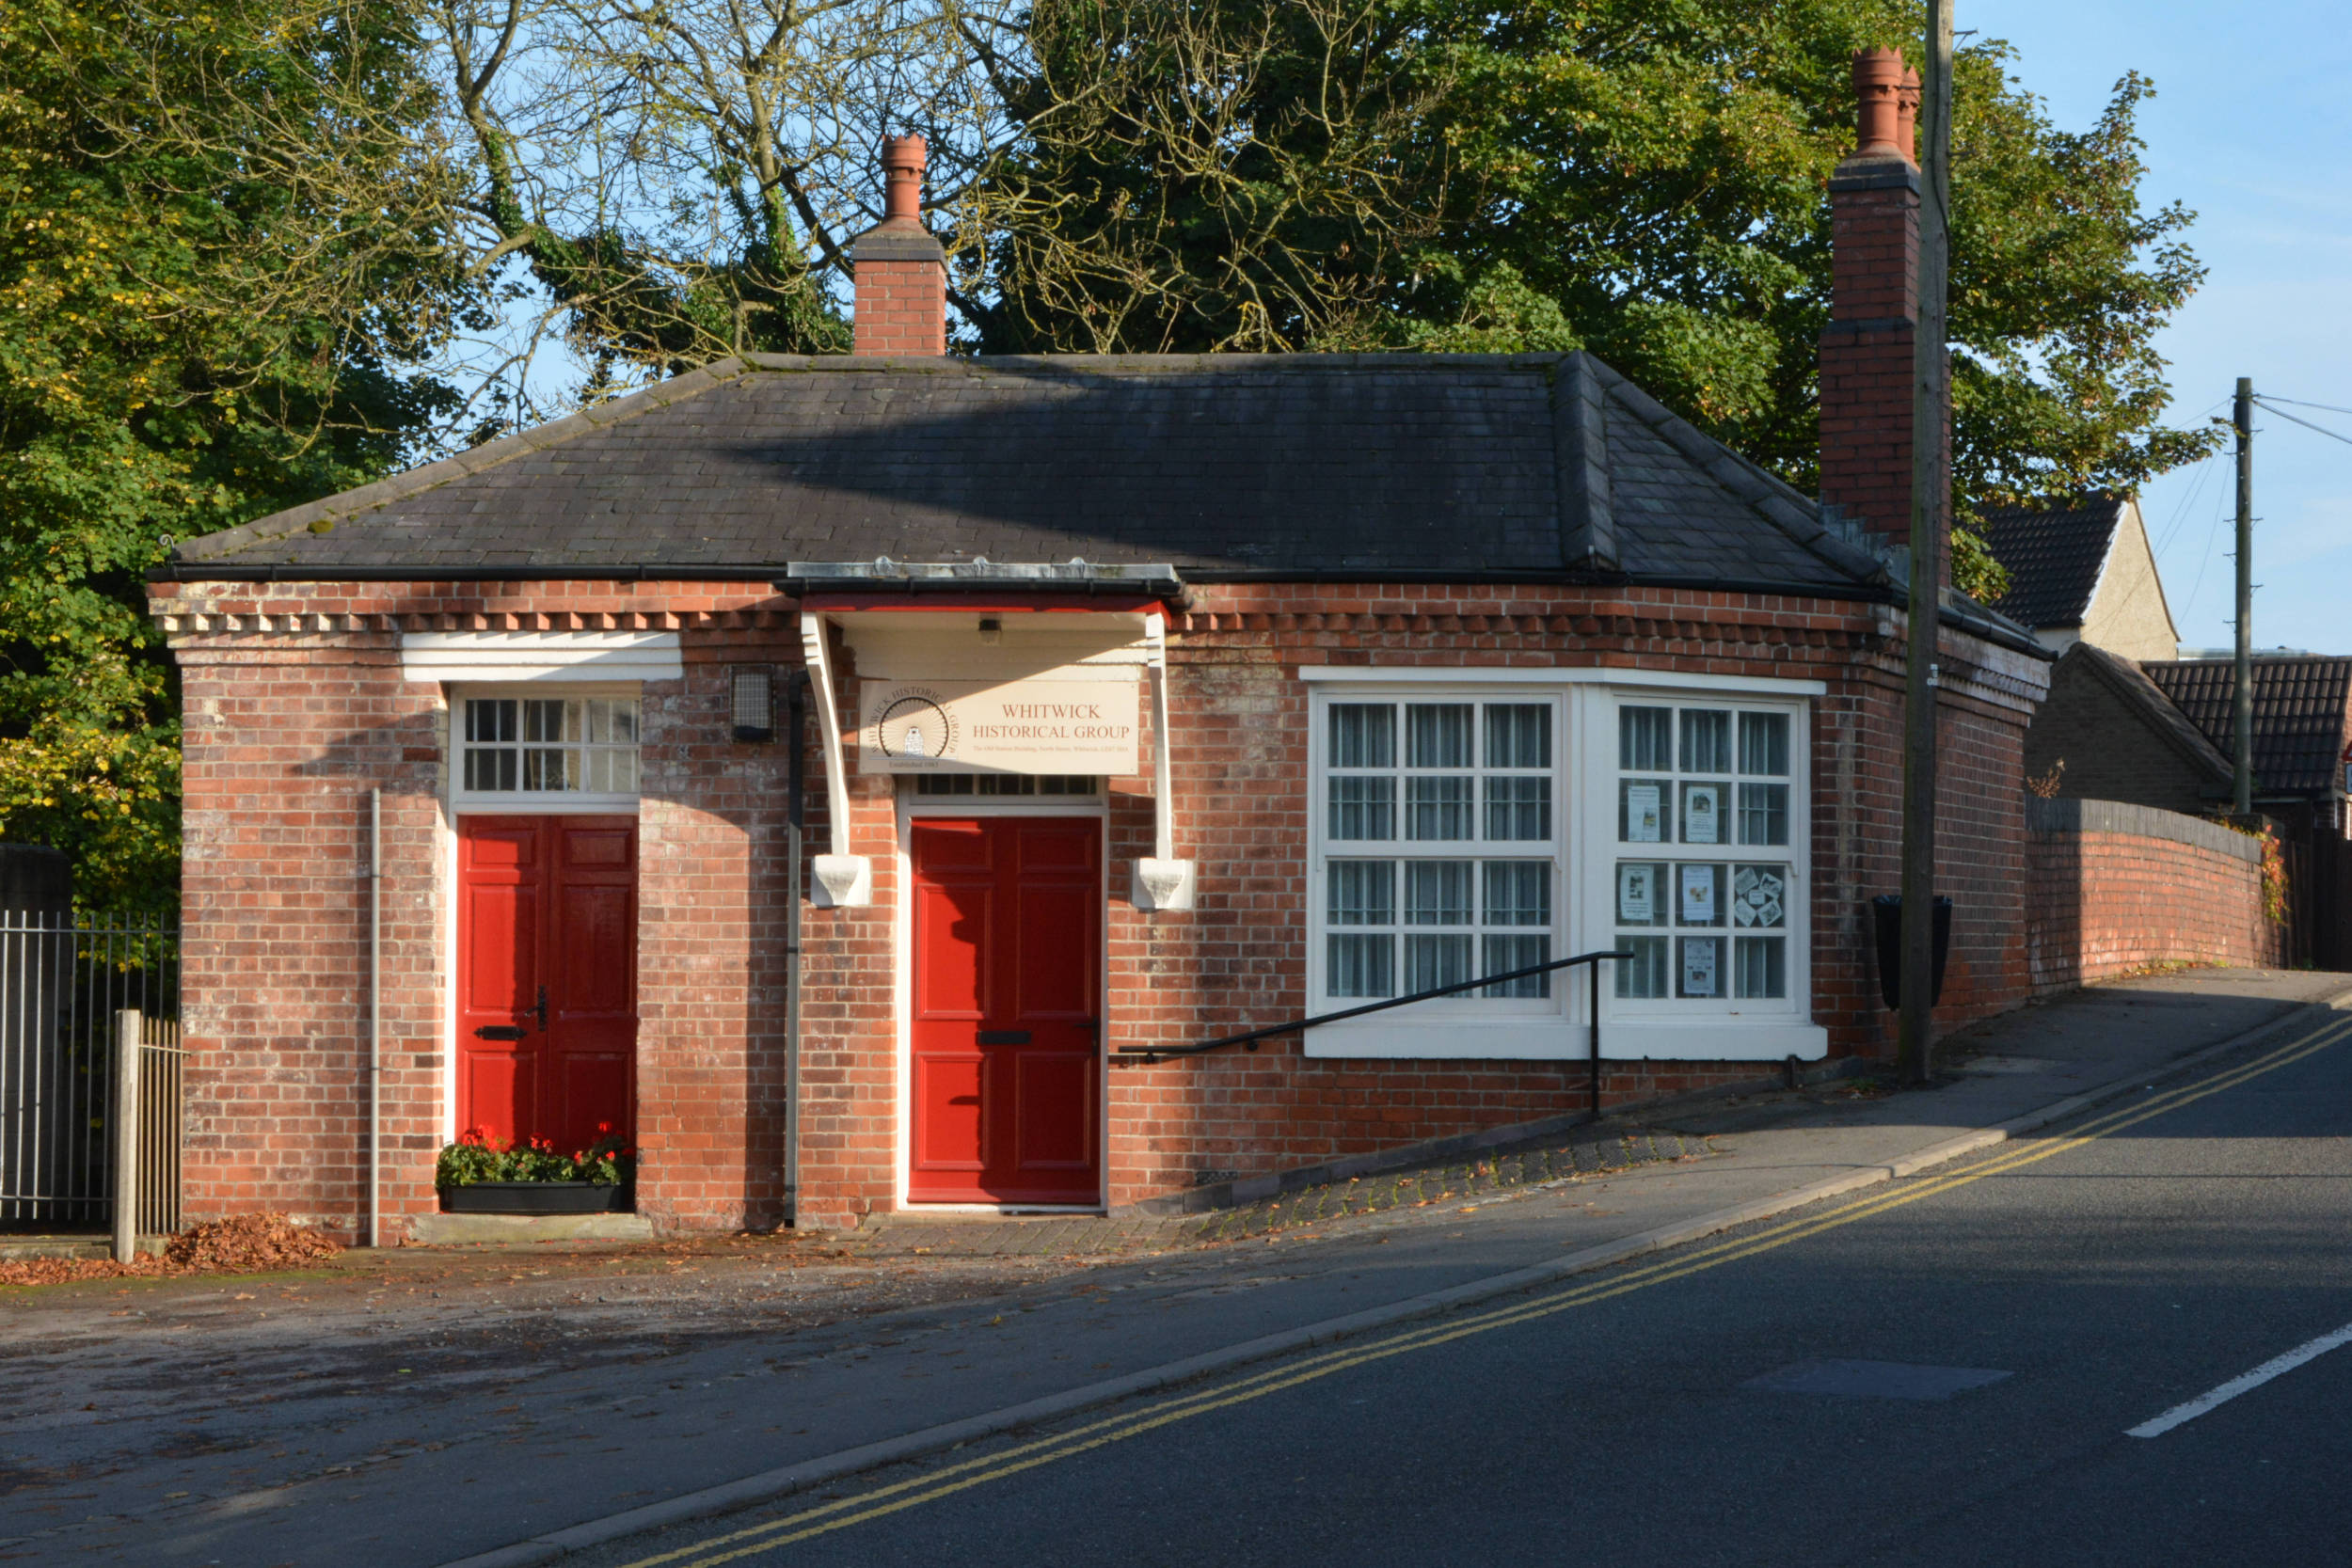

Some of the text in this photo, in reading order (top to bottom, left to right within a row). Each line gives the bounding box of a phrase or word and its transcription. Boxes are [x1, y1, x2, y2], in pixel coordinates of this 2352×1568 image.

[1002, 704, 1101, 719] WHITWICK
[948, 715, 961, 753] GROUP
[973, 724, 1130, 738] HISTORICAL GROUP
